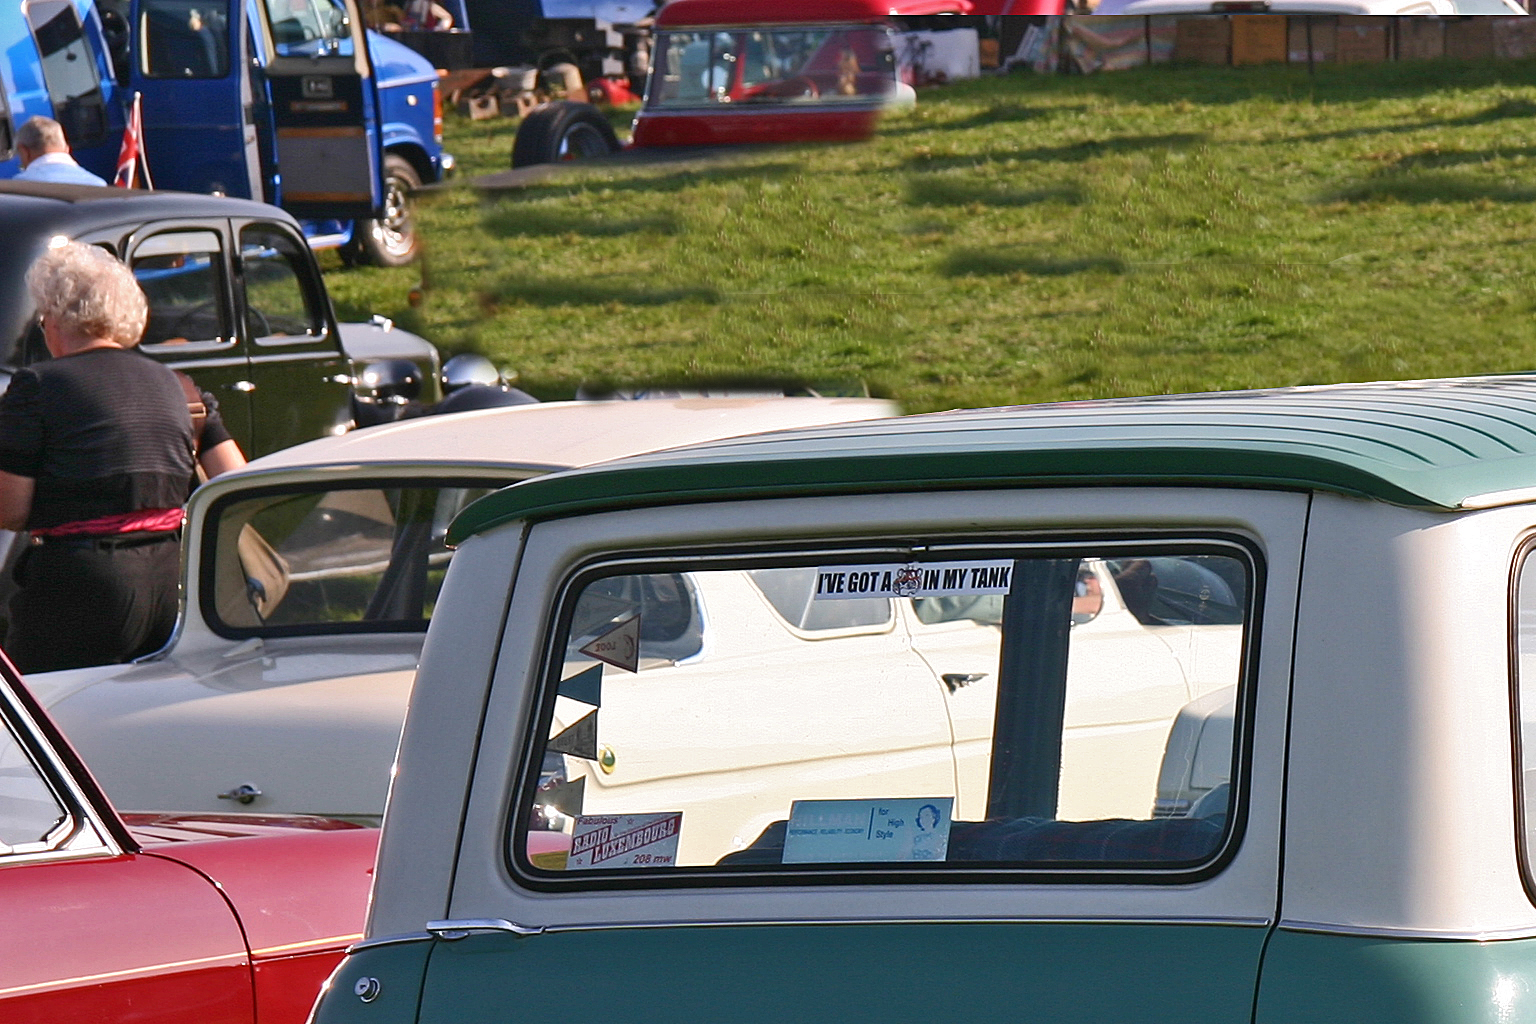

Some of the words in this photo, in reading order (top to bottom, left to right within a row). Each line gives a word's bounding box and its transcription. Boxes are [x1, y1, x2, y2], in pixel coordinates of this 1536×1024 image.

[817, 572, 845, 594] I'VE
[849, 571, 880, 593] GOT
[880, 571, 892, 592] A
[922, 569, 940, 591] IN
[942, 568, 969, 590] MY
[970, 566, 1011, 589] TANK
[878, 807, 889, 816] for
[887, 818, 904, 828] High
[875, 830, 894, 840] Style
[572, 826, 610, 855] RADIO
[593, 818, 675, 863] LUXEMBOURG
[633, 854, 650, 864] 208
